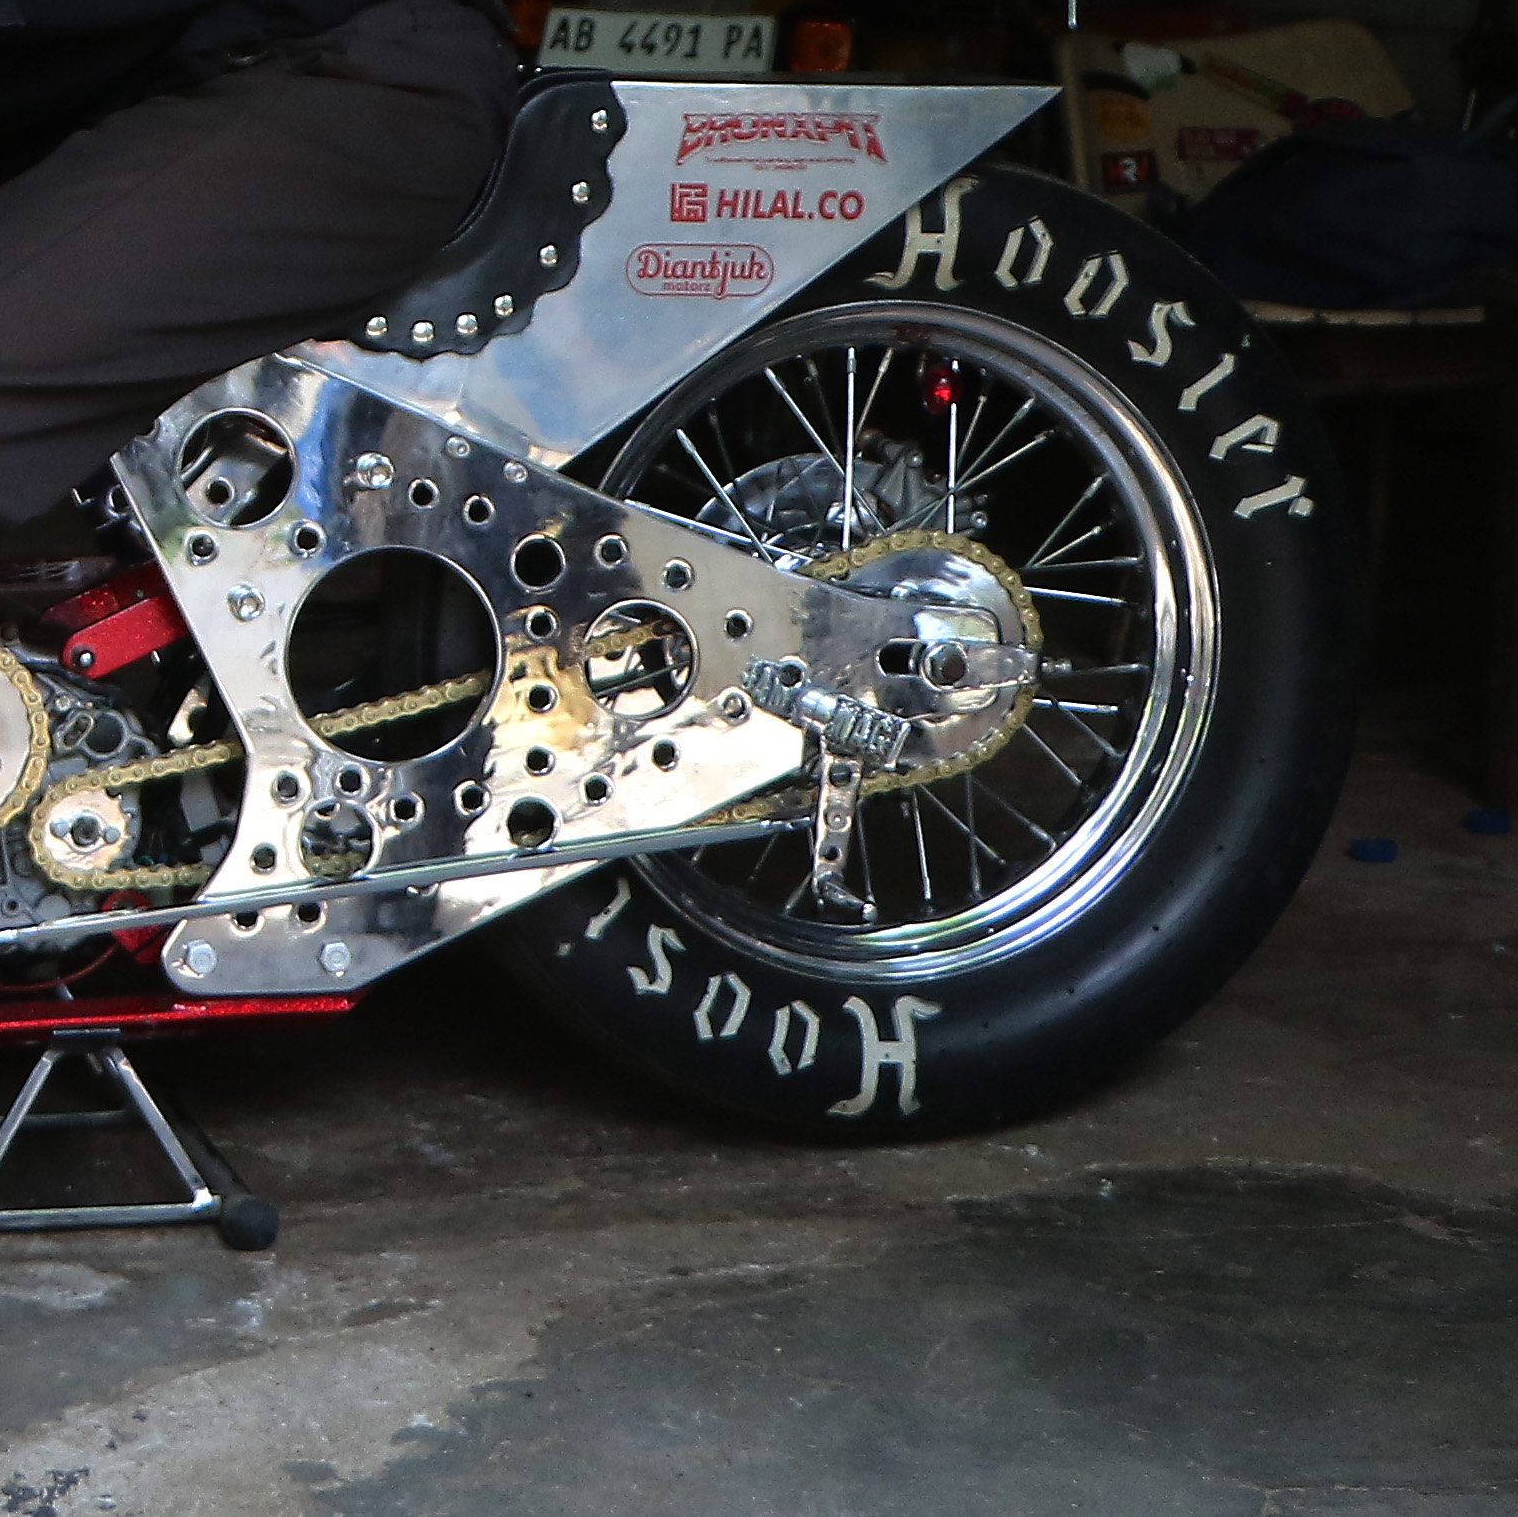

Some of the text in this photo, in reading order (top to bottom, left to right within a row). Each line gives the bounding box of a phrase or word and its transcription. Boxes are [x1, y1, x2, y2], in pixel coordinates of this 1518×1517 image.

[550, 15, 763, 59] AB 4491 PA
[717, 189, 864, 220] HILAL.CO
[866, 175, 1315, 520] Hoosier
[556, 878, 944, 1117] Hoosi
